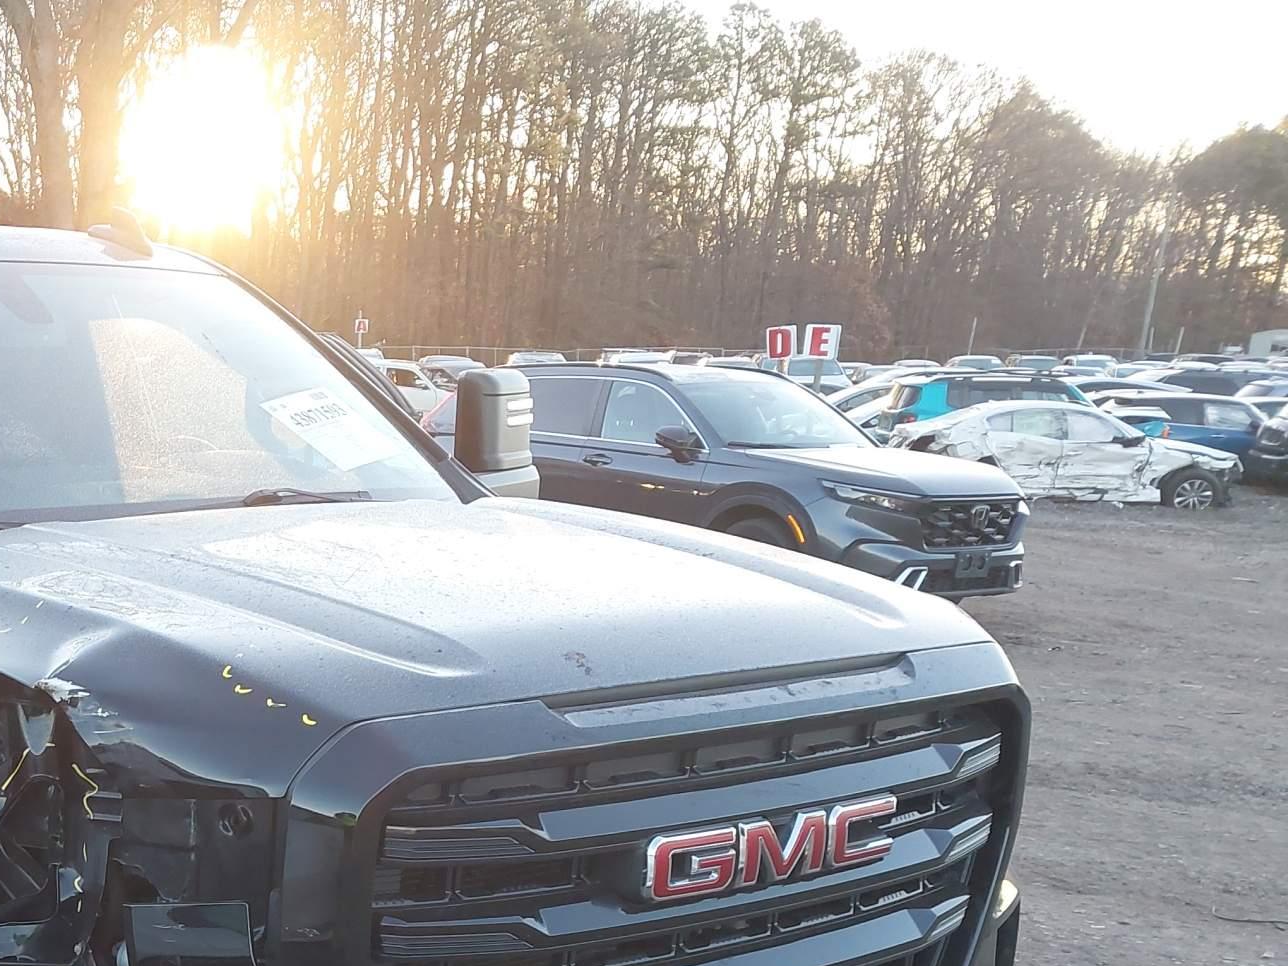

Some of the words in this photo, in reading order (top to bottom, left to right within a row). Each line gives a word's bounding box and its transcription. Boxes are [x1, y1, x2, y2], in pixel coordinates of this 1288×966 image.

[357, 321, 367, 331] A
[809, 327, 831, 356] E
[645, 794, 898, 901] GMC
